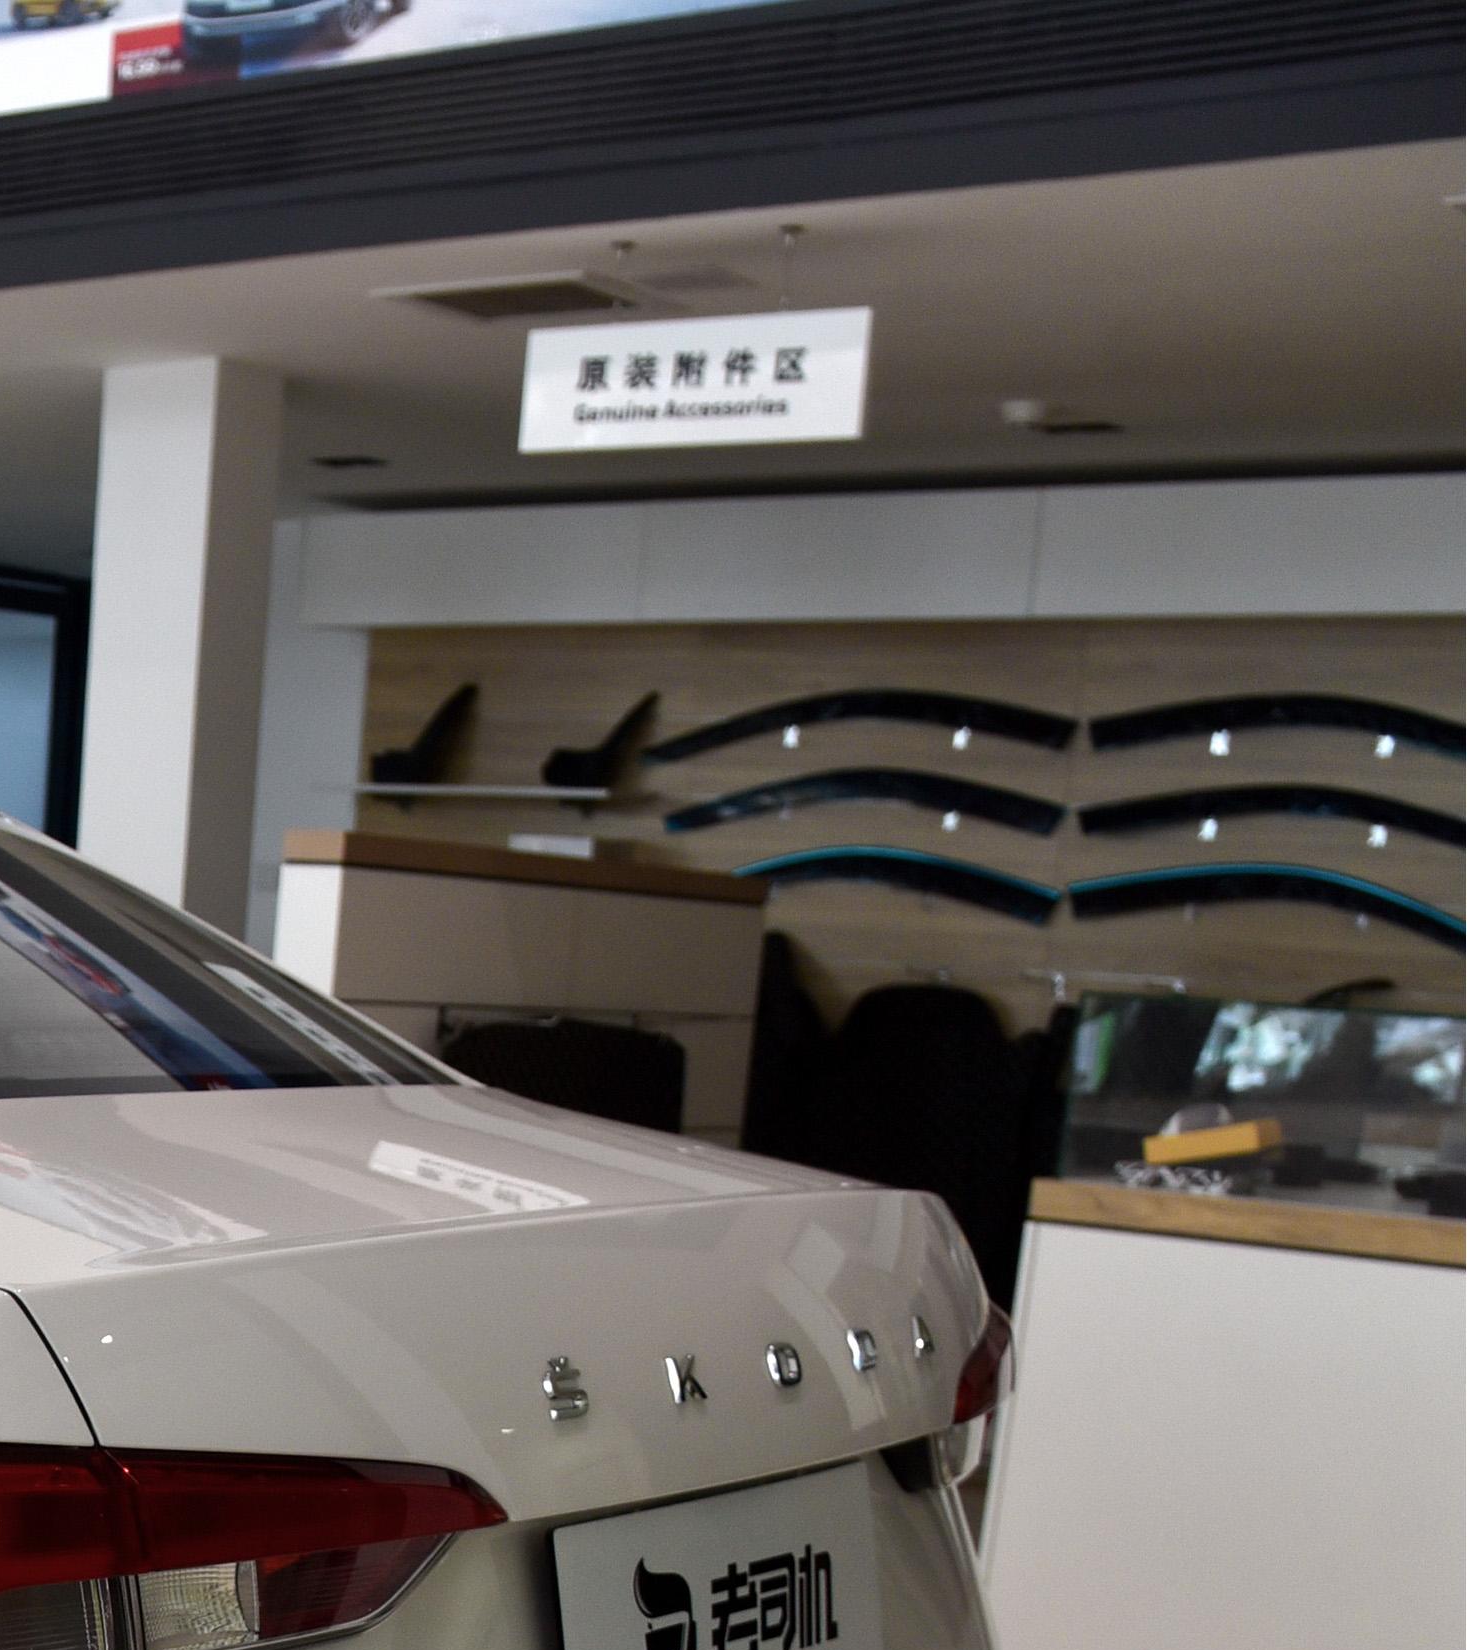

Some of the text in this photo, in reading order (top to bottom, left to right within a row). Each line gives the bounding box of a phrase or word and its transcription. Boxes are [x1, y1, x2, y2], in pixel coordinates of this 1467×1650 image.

[577, 346, 807, 392] 原装附件区
[574, 394, 789, 424] Genuine Accessories
